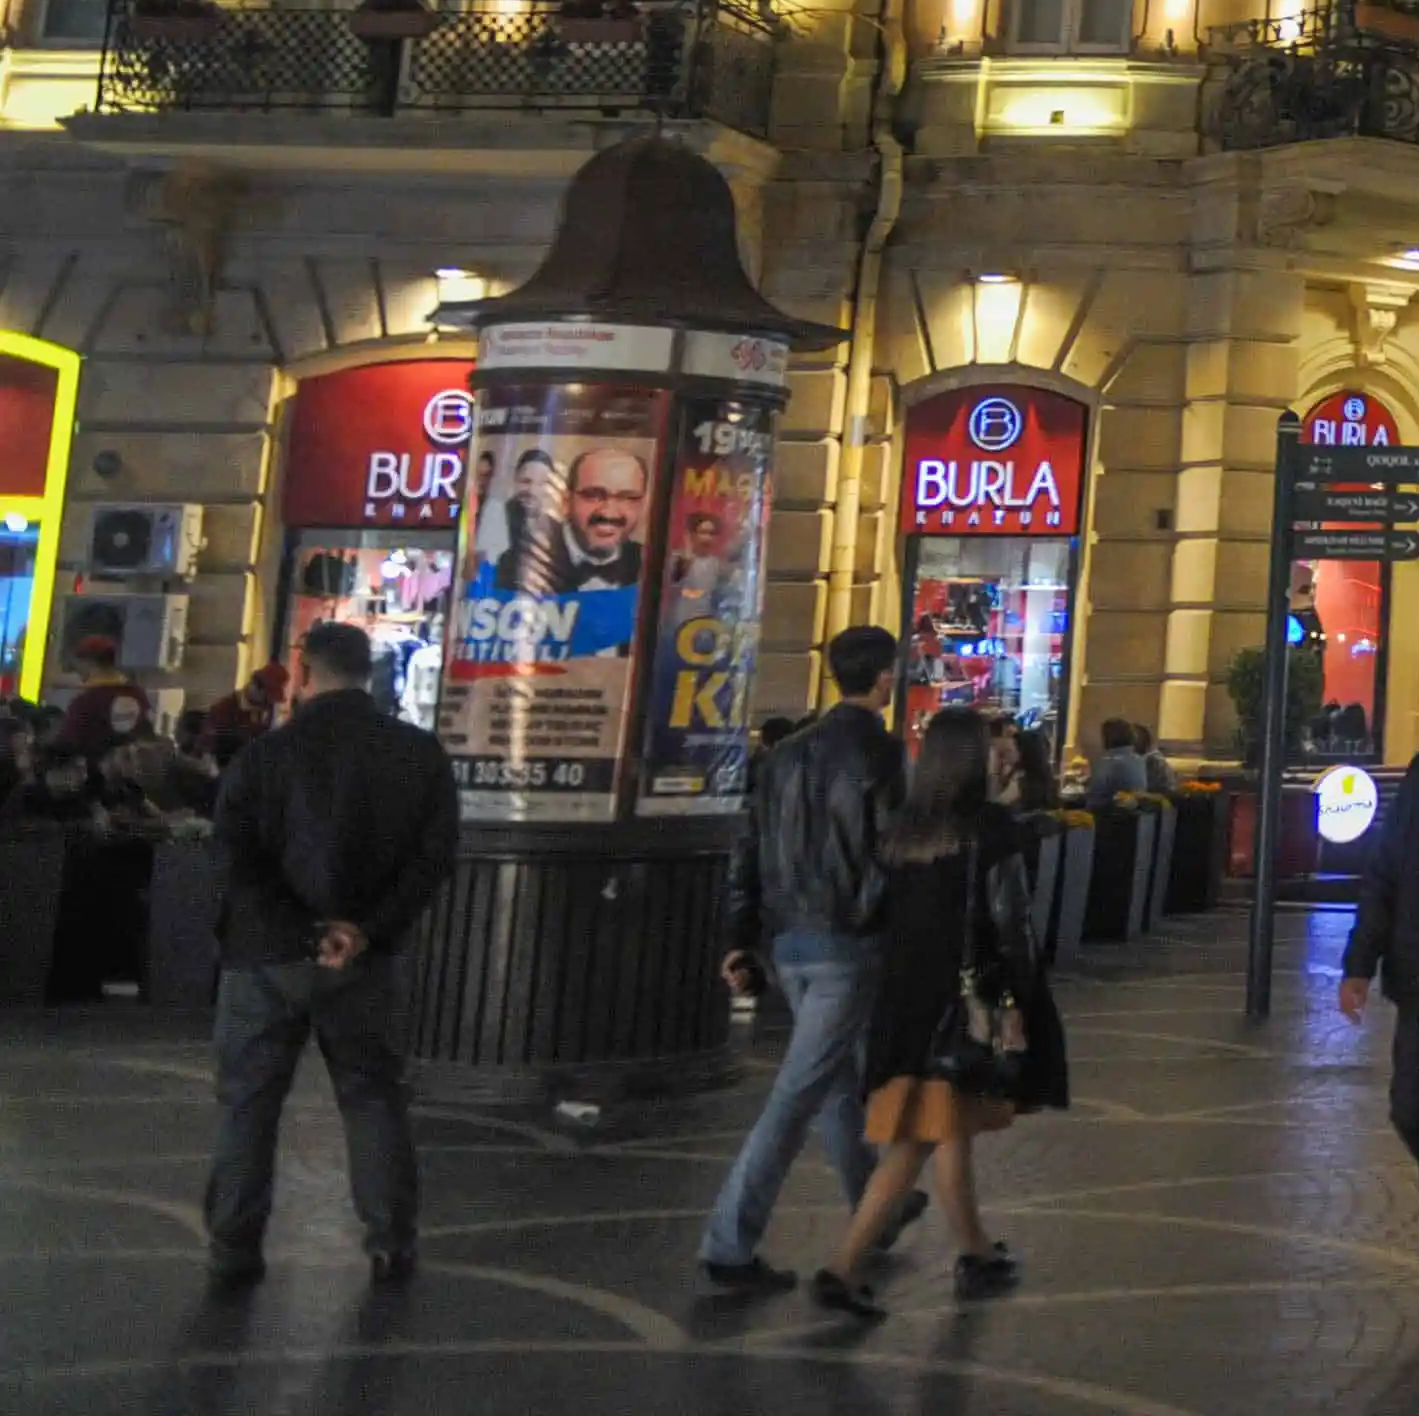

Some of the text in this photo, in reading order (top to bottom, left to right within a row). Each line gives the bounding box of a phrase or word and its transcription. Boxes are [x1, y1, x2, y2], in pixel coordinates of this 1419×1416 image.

[367, 451, 463, 499] BUR
[917, 459, 1060, 506] BURLA
[553, 762, 584, 786] 40
